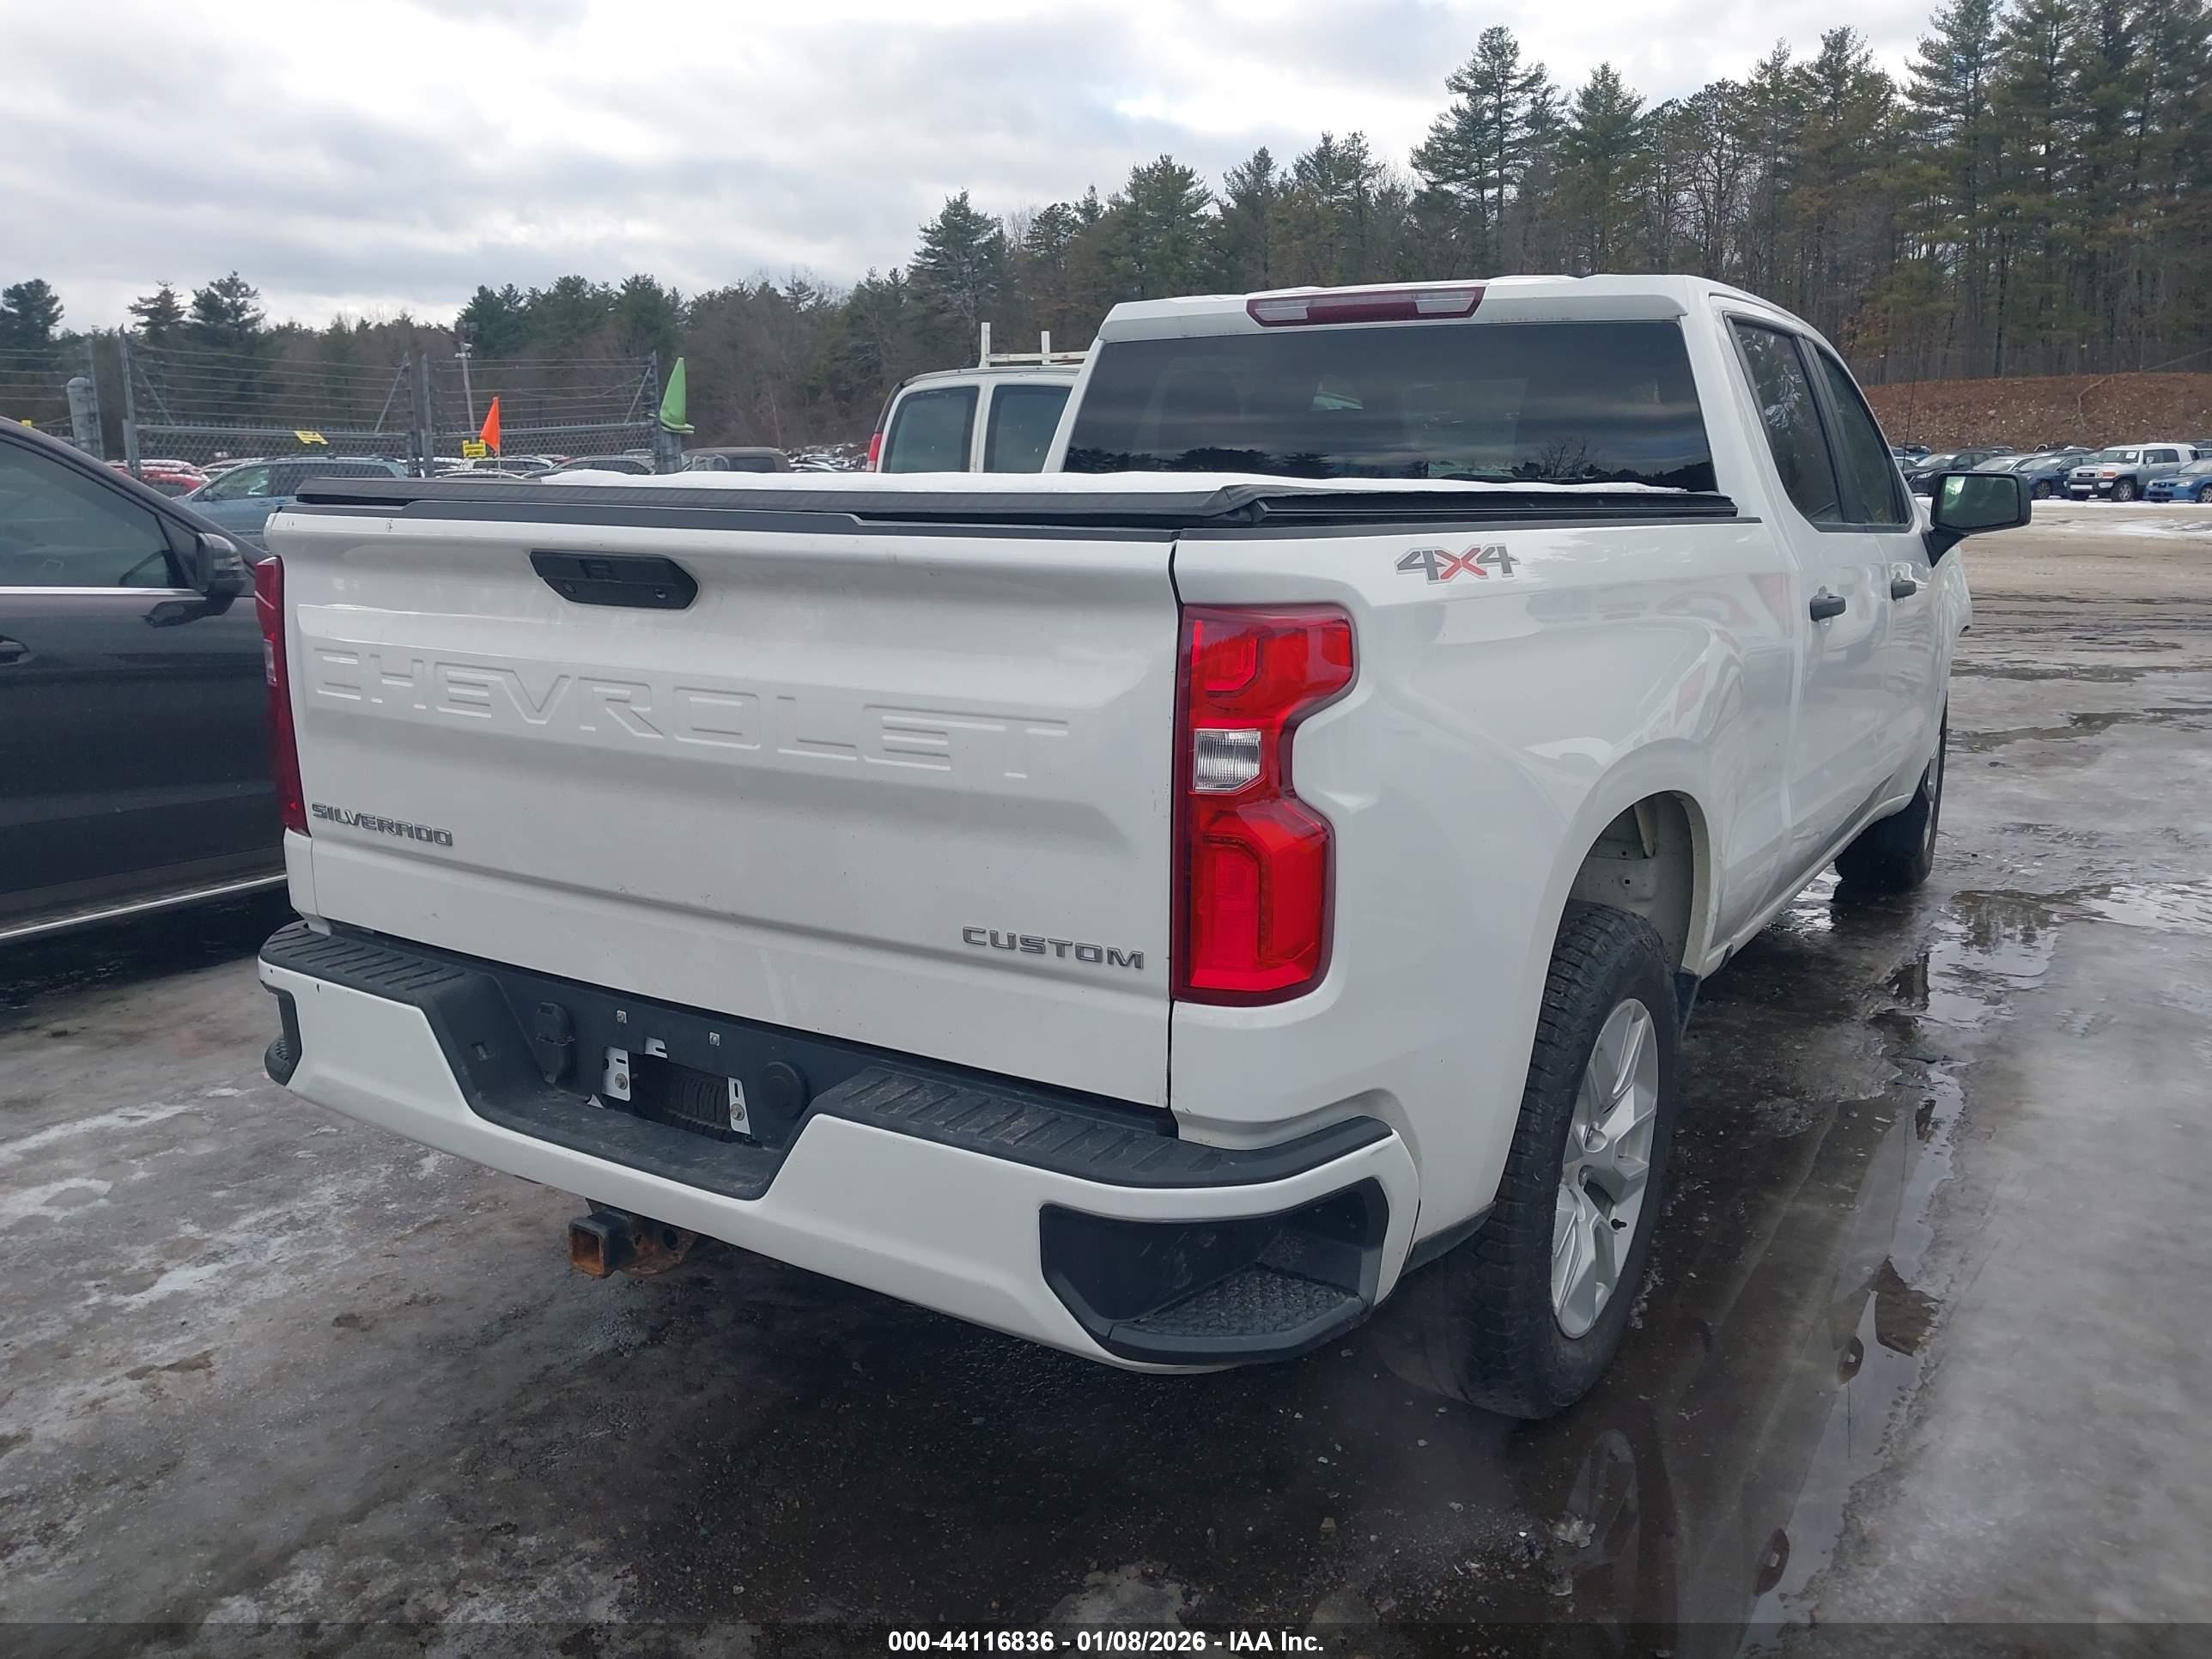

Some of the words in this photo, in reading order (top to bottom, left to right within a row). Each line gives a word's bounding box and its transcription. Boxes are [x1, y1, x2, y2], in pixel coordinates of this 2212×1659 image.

[314, 647, 1070, 780] CHEVROLET
[312, 803, 453, 847] SILVERADO
[963, 926, 1144, 969] CUSTOM
